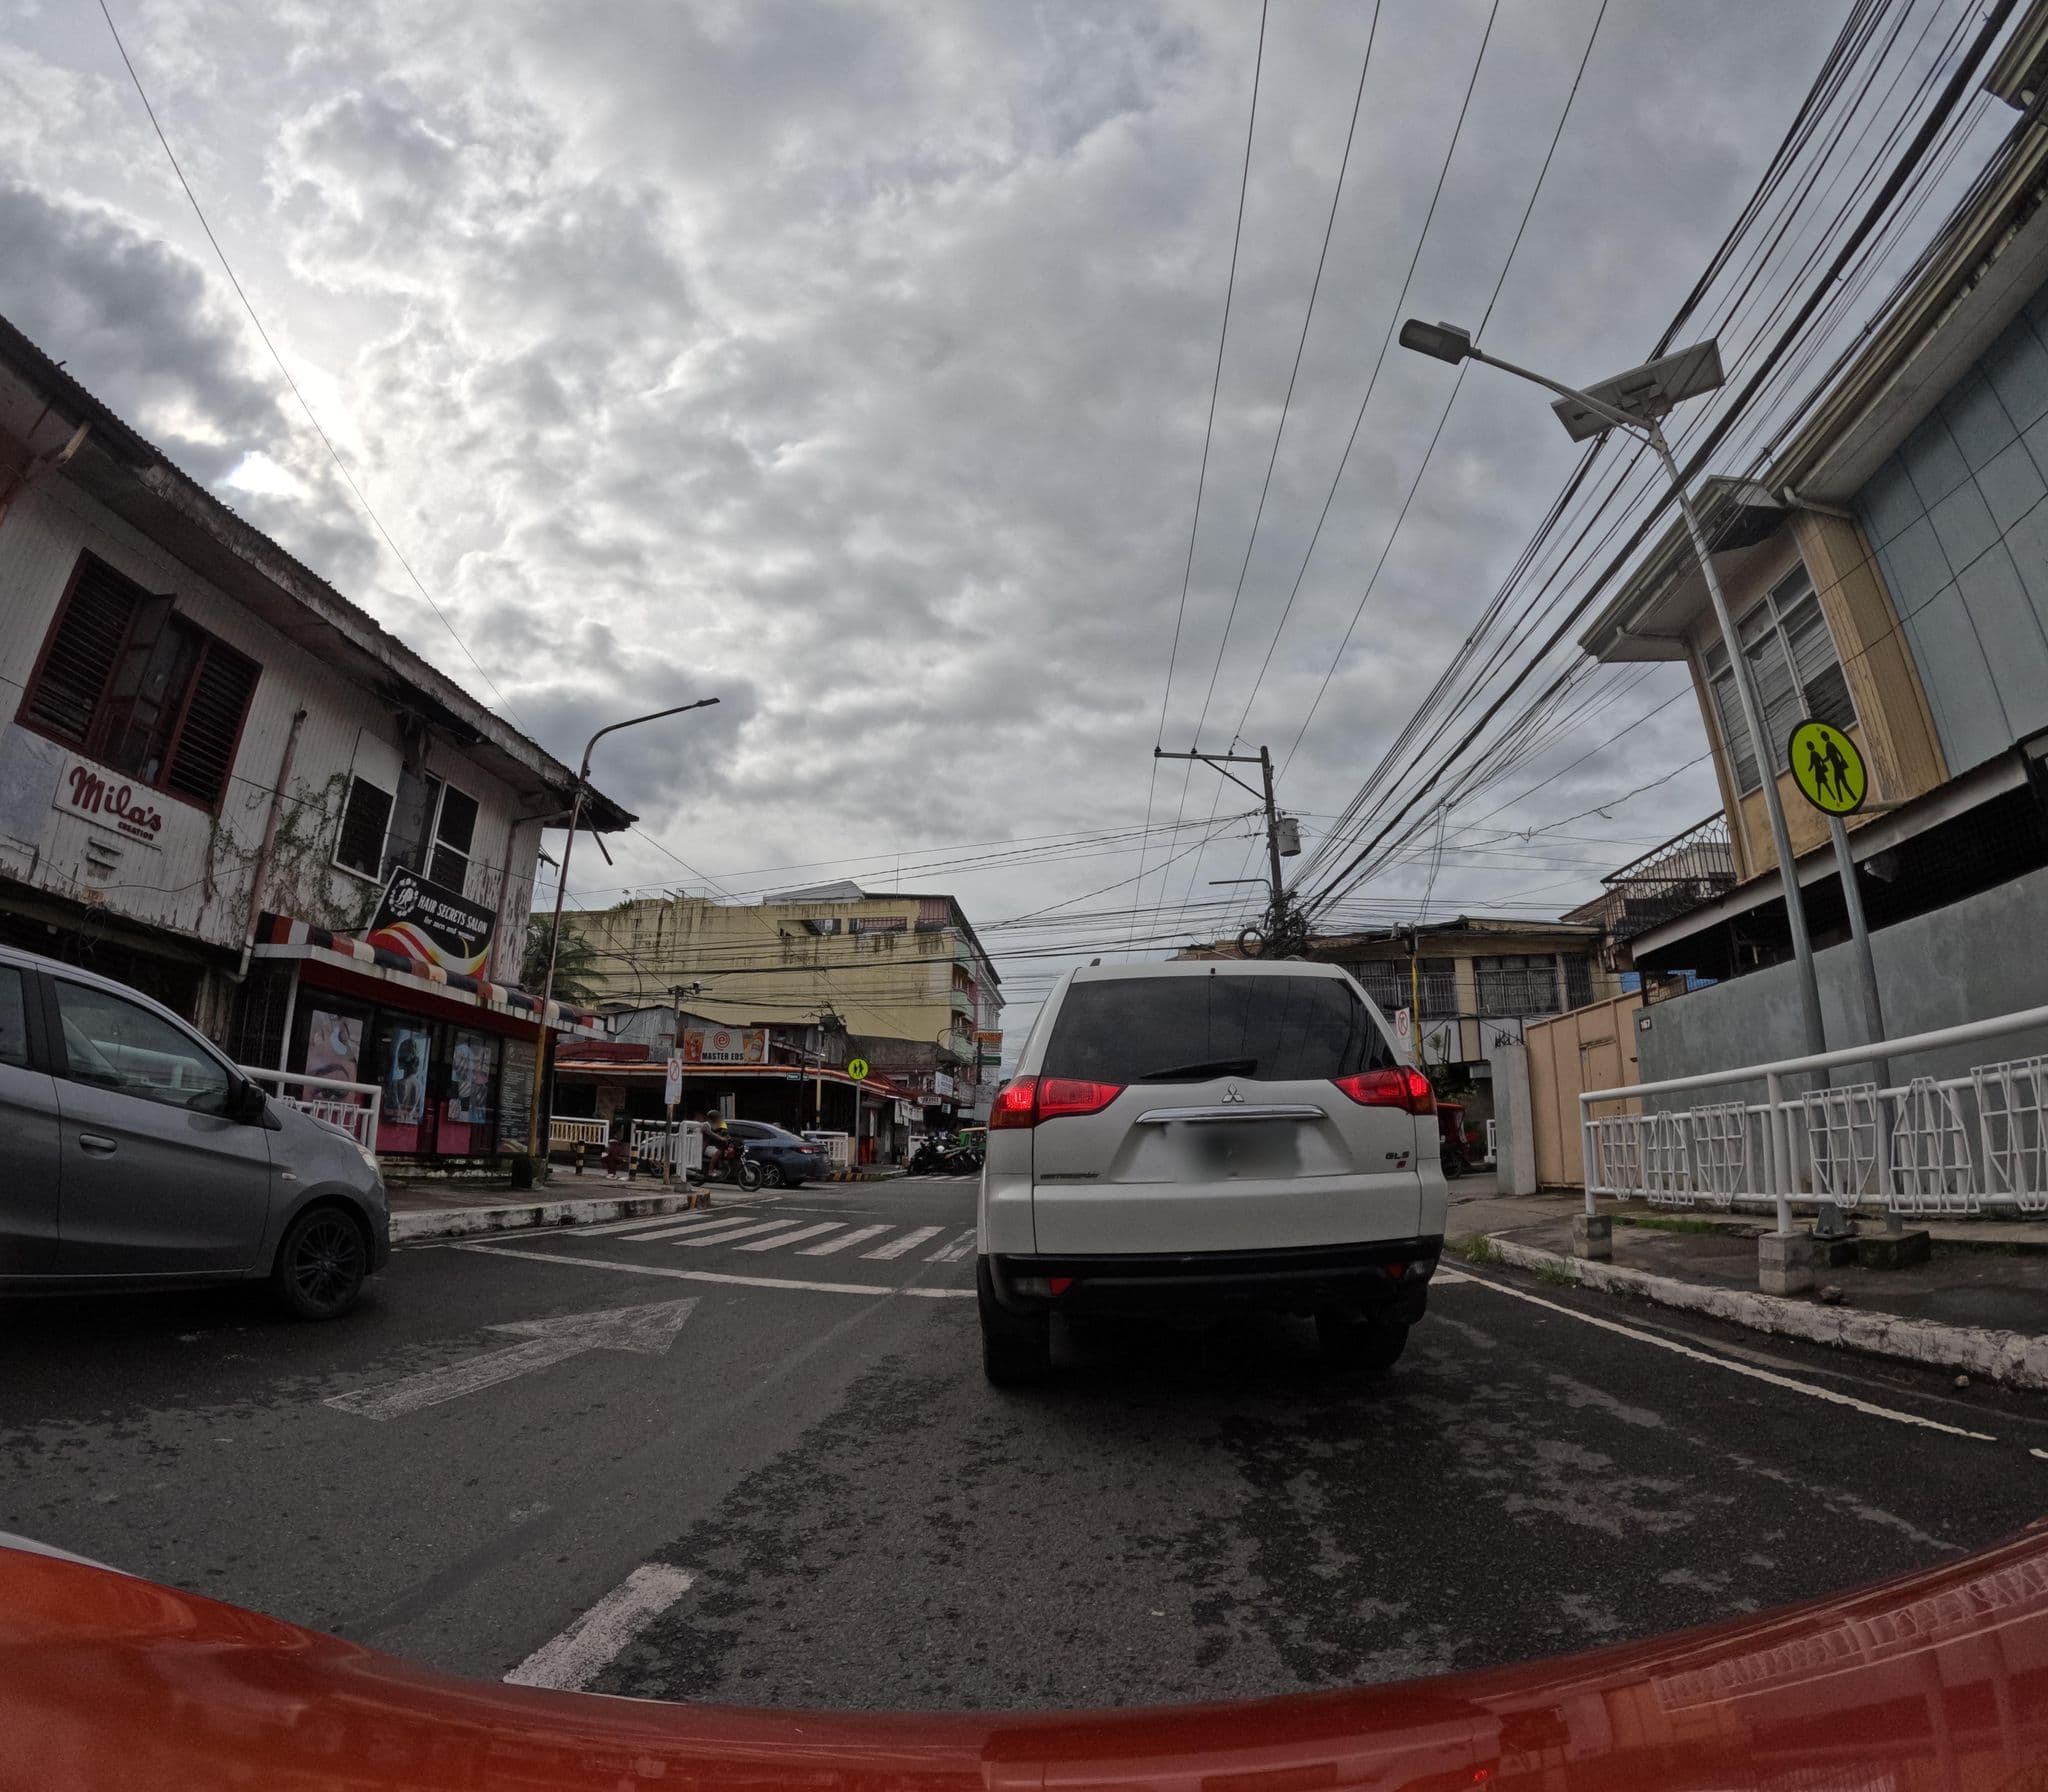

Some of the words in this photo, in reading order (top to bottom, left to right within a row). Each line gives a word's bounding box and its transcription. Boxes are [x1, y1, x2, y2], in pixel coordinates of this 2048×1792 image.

[69, 766, 162, 832] Mila's
[118, 821, 154, 841] CREATION
[417, 895, 438, 914] HAIR
[437, 903, 467, 926] SECRETS
[465, 916, 489, 935] SALON
[702, 1052, 729, 1061] MASTER
[1385, 1151, 1410, 1160] GLS
